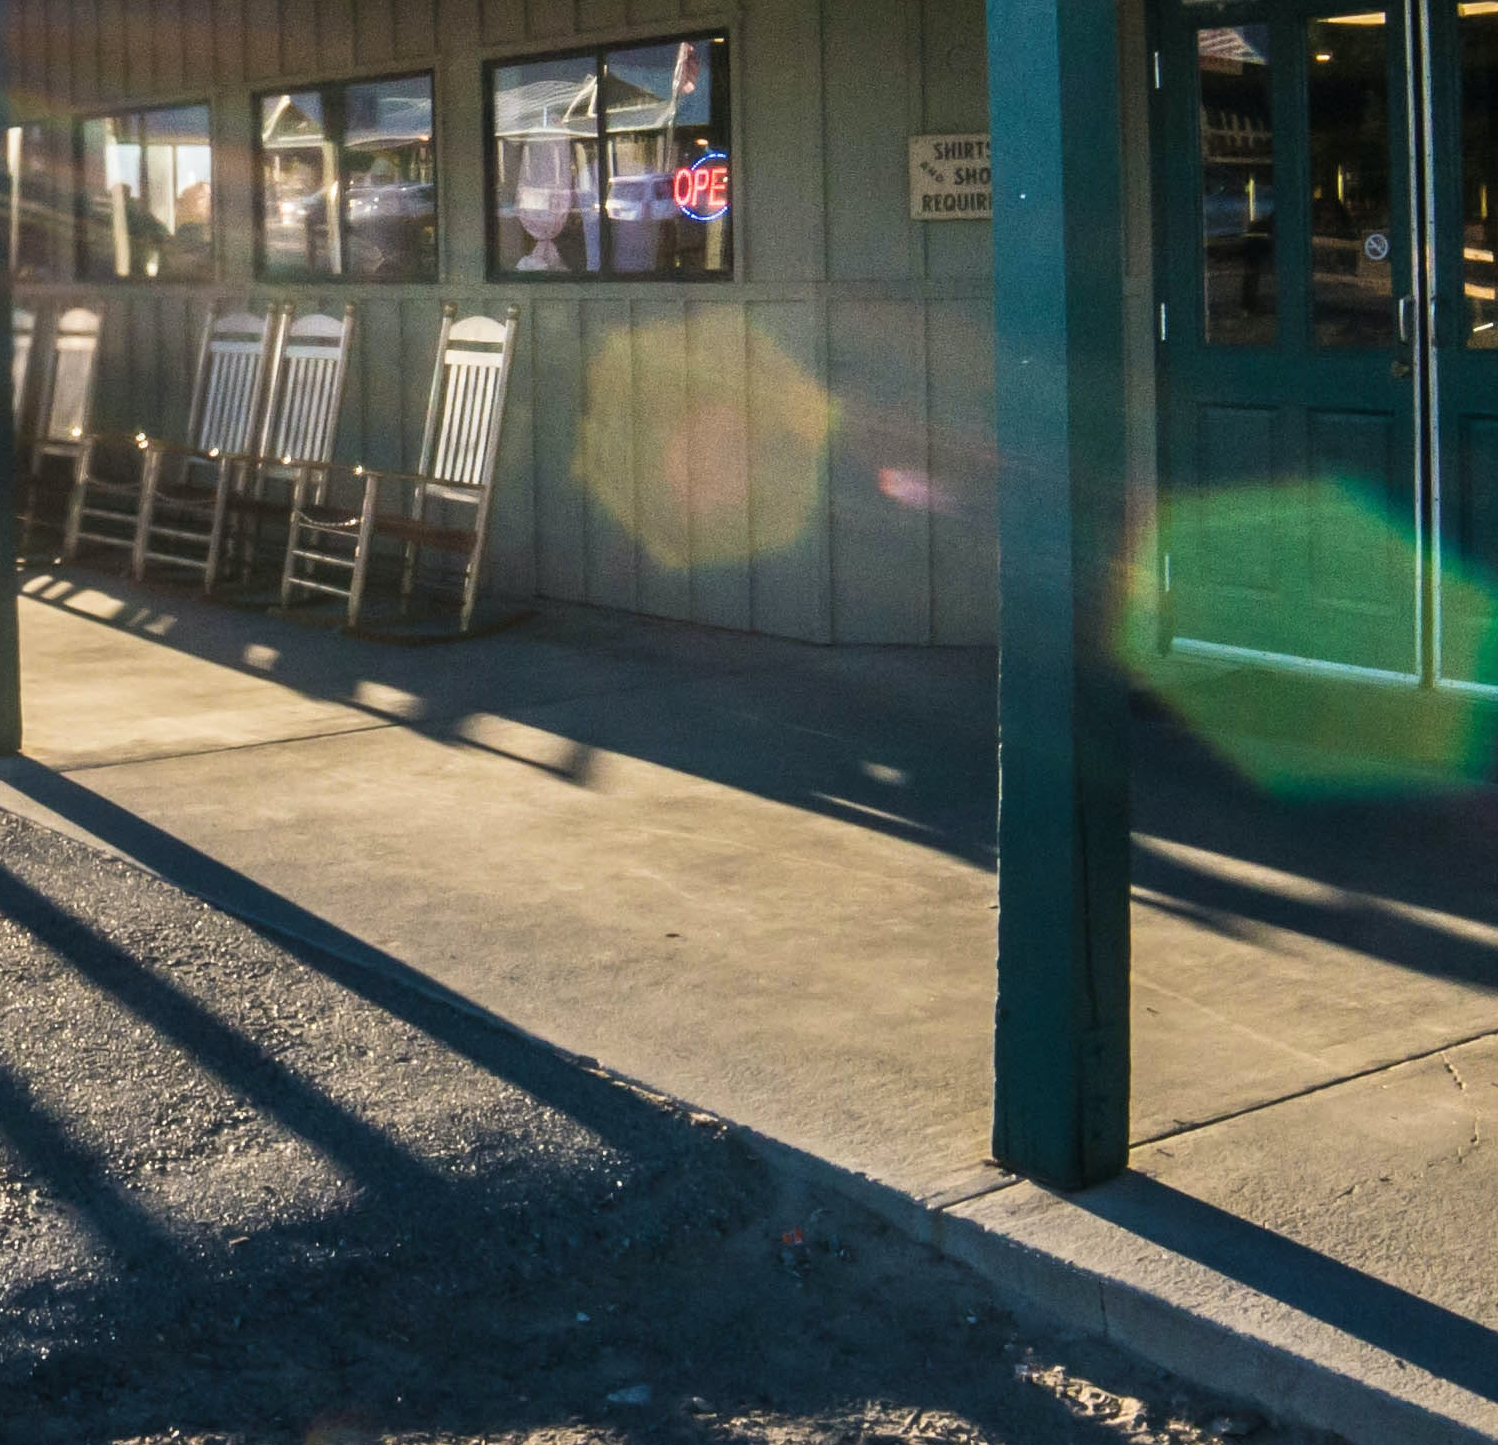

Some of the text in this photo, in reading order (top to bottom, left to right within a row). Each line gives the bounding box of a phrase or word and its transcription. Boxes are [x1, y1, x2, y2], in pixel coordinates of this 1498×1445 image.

[954, 167, 991, 185] SHO
[673, 166, 728, 207] OPE
[922, 193, 992, 212] REQUIR
